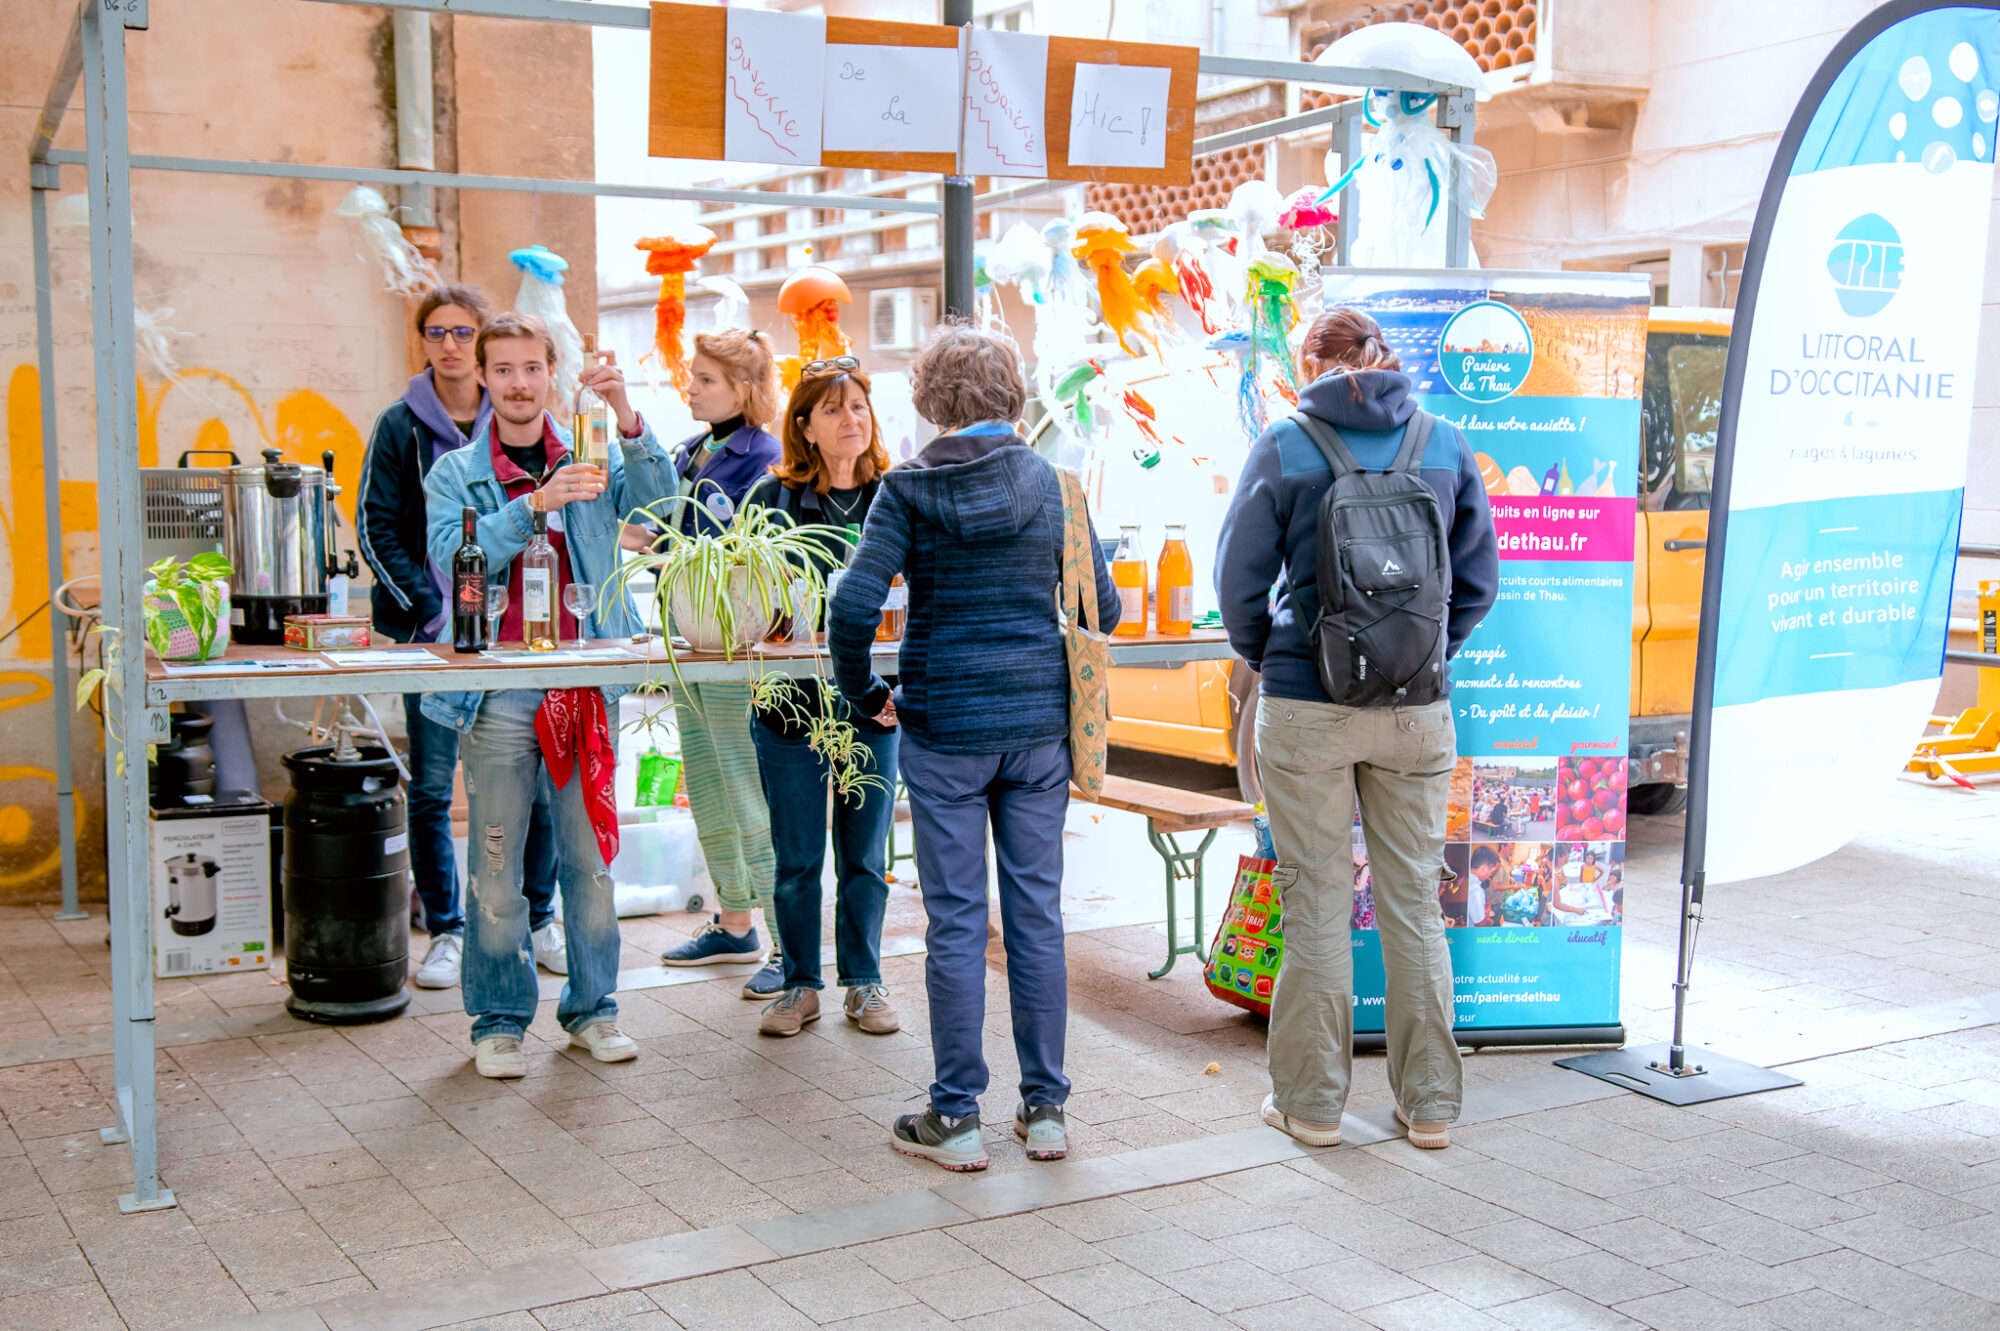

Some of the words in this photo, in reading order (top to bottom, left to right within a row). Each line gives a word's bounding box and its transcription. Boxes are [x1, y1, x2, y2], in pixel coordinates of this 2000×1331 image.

[1802, 333, 1925, 363] LITTORAL
[1462, 355, 1511, 374] Paniers
[1459, 374, 1475, 392] de
[1478, 375, 1512, 393] Thau
[1770, 368, 1955, 400] D'OCCITANIE
[1467, 414, 1495, 431] dans
[1496, 416, 1529, 431] votre
[1530, 416, 1577, 432] assiette
[1523, 508, 1540, 518] en
[1543, 506, 1576, 522] ligne
[1578, 508, 1601, 519] sur
[1780, 559, 1811, 582] Agir
[1813, 550, 1904, 574] ensemble
[1528, 576, 1561, 587] courts
[1562, 576, 1624, 587] alimentaires
[1523, 590, 1536, 600] de
[1539, 590, 1567, 601] Thau.
[1767, 589, 1802, 612] pour
[1804, 586, 1825, 601] un
[1831, 577, 1920, 599] territoire
[1771, 610, 1813, 633] vivant
[1818, 609, 1836, 627] et
[1842, 602, 1916, 625] durable
[1464, 644, 1508, 665] engagés
[1455, 673, 1504, 689] moments
[1505, 672, 1520, 689] de
[1522, 674, 1583, 689] rencontres
[1469, 703, 1488, 719] Du
[1489, 703, 1517, 725] goût
[1518, 703, 1532, 719] et
[1533, 702, 1551, 719] du
[1550, 702, 1591, 724] plaisir
[1493, 735, 1539, 749] convivial
[1570, 735, 1619, 755] gourmand
[1476, 931, 1503, 944] vente
[1504, 930, 1540, 944] directe
[1566, 929, 1608, 946] éducatif
[1453, 974, 1475, 984] otre
[1477, 973, 1520, 984] actualité
[1522, 975, 1539, 984] sur
[1459, 1014, 1476, 1023] sur
